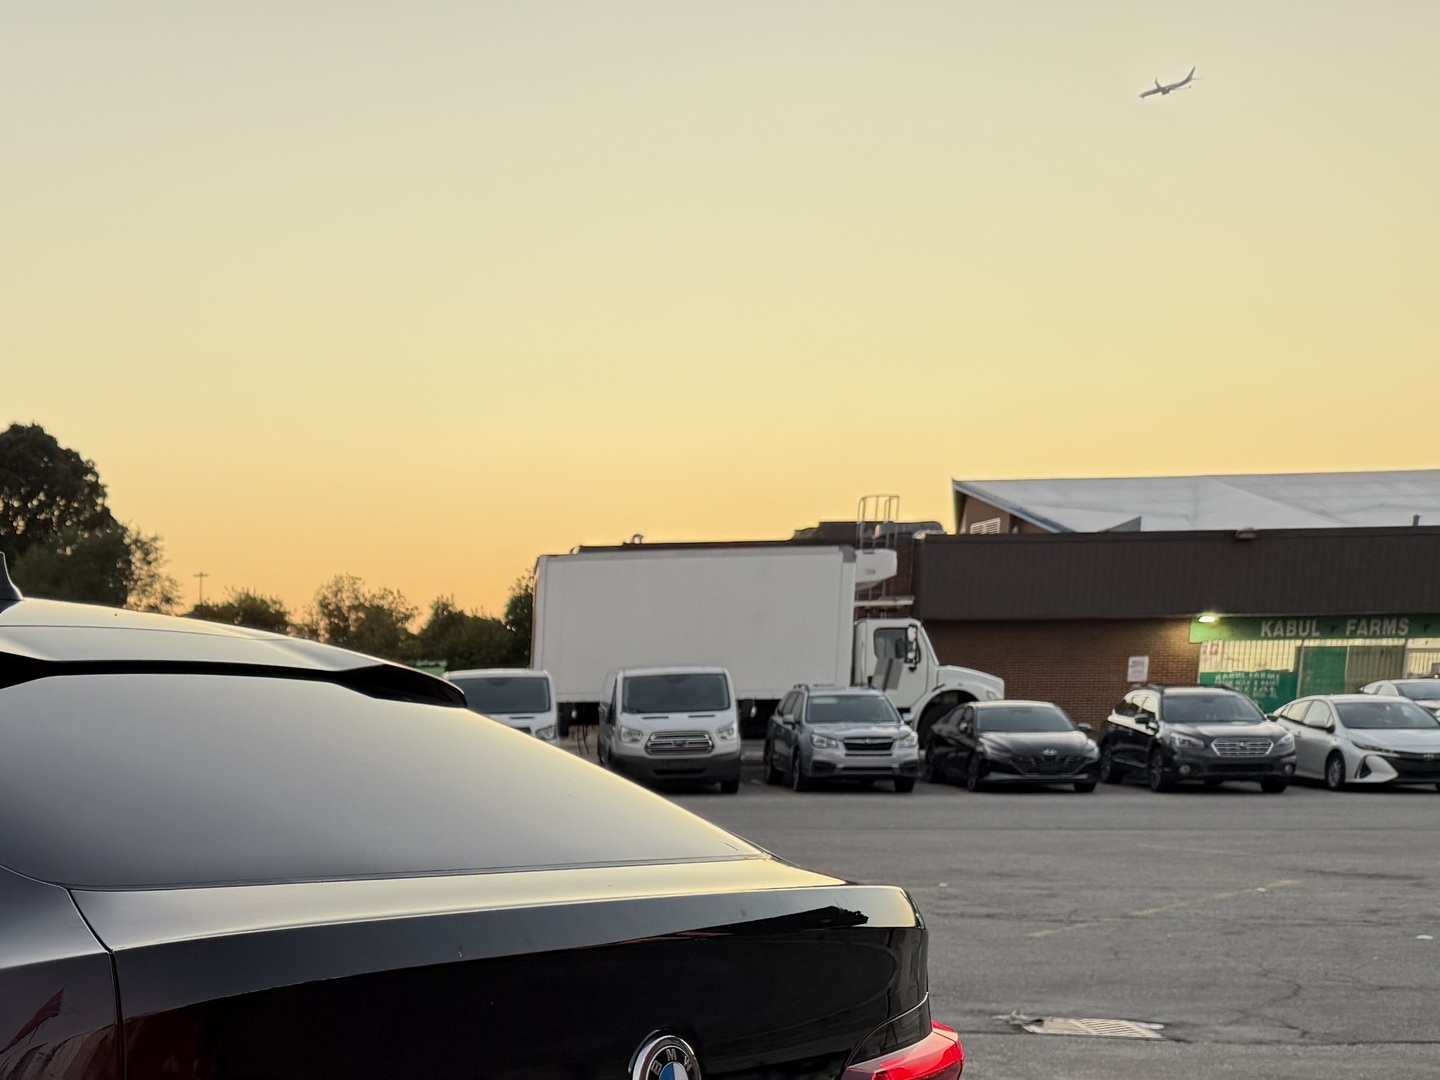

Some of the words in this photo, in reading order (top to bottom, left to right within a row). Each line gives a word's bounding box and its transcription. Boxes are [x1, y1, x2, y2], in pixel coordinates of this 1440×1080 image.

[1260, 619, 1321, 638] KABUL
[1345, 617, 1410, 637] FARMS
[651, 1048, 692, 1076] BMW
